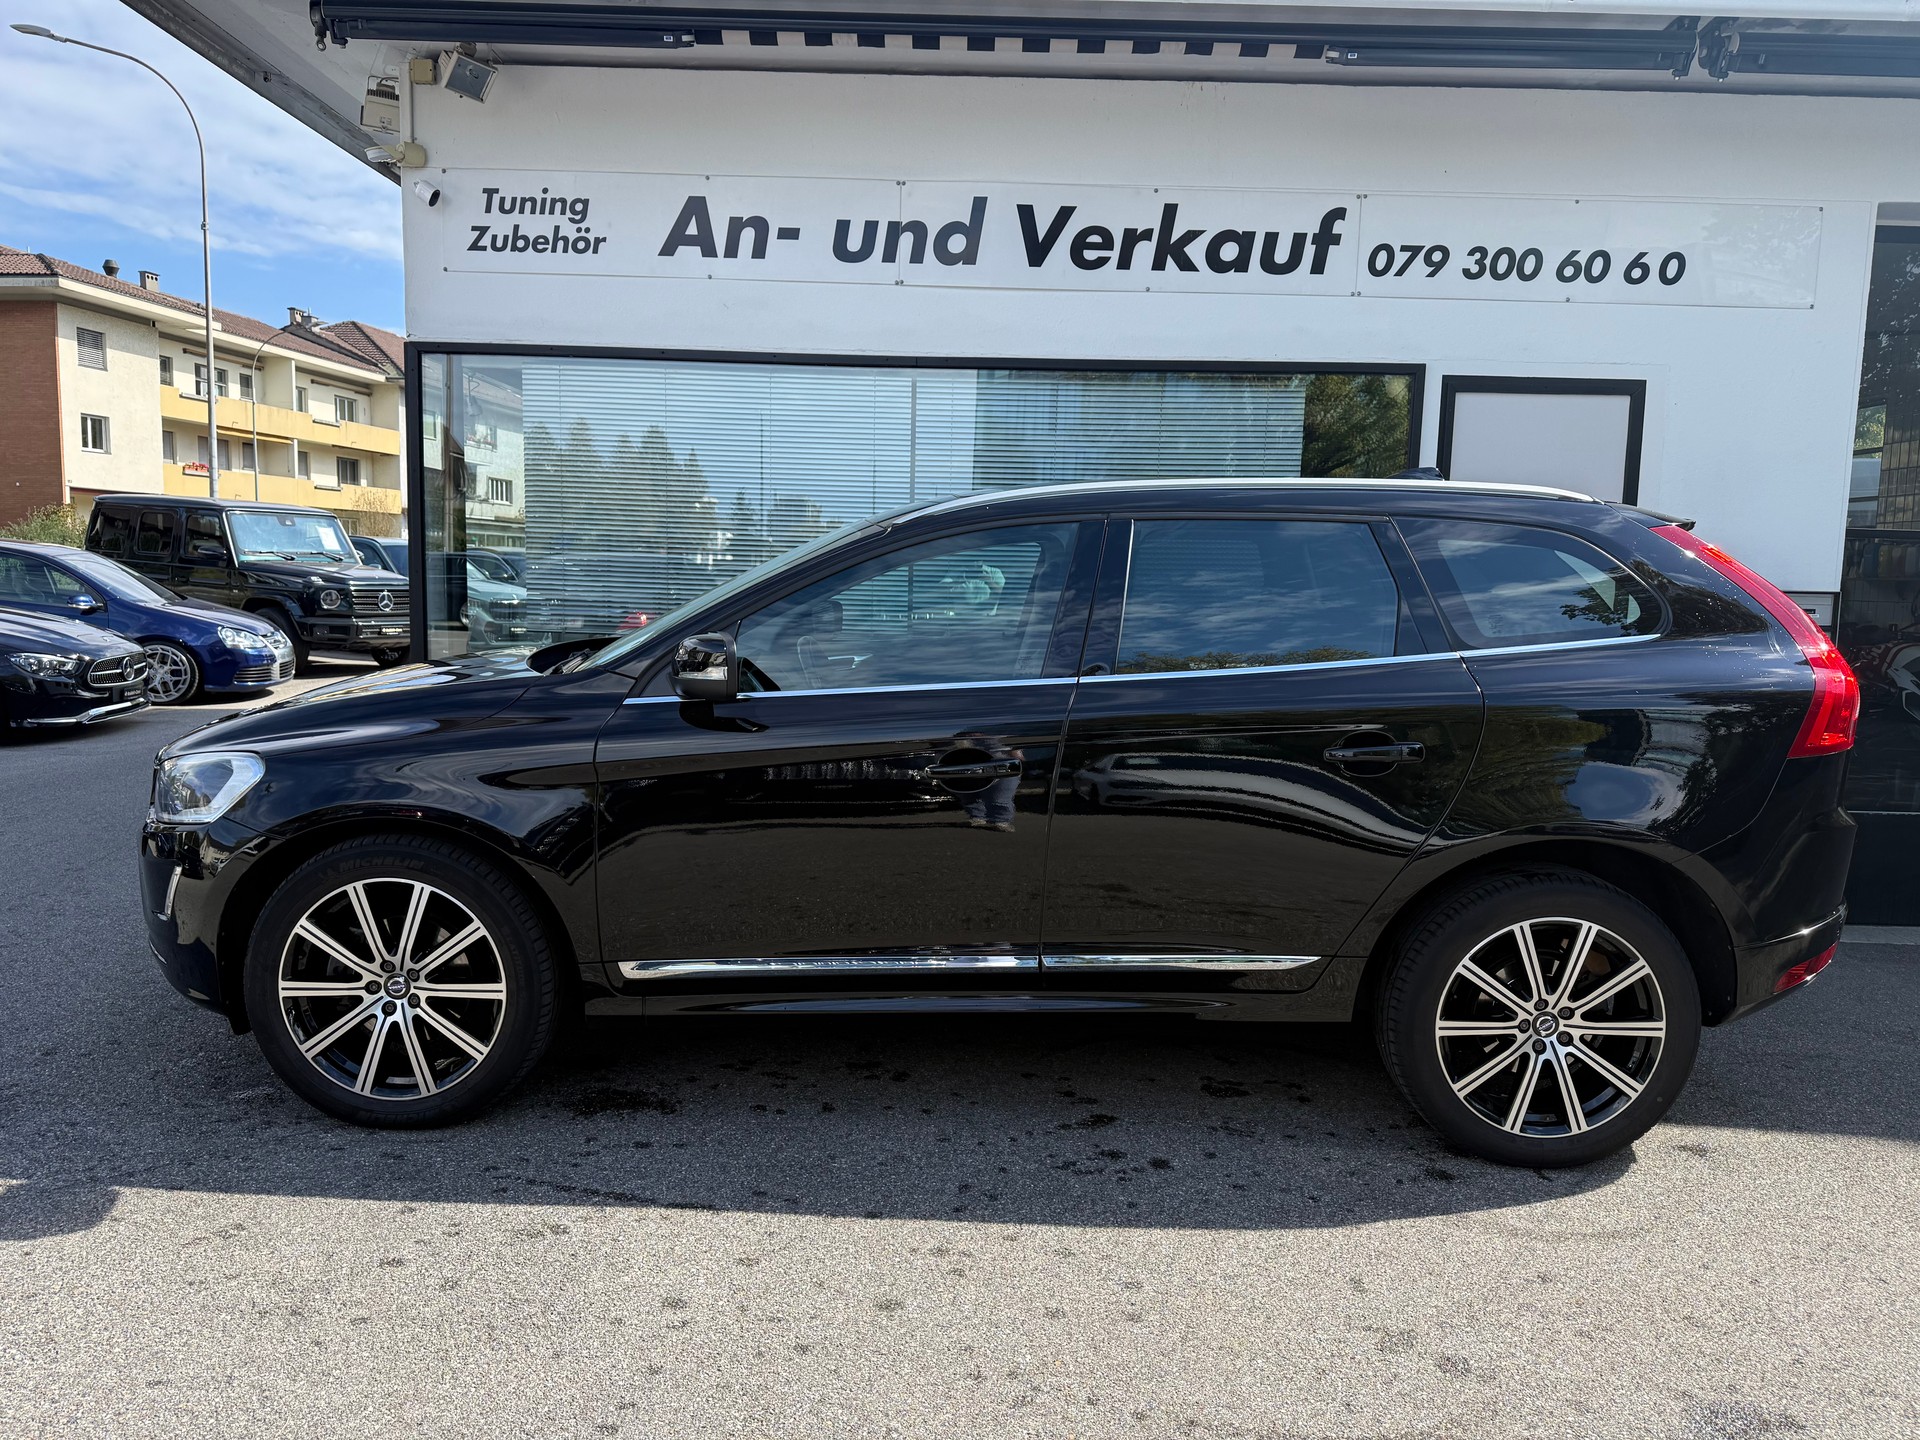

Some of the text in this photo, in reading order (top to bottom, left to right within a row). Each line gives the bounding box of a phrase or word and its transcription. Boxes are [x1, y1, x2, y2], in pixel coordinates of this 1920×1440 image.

[482, 188, 590, 225] Tuning
[467, 226, 607, 256] Zubehör
[658, 195, 1348, 276] An- und Verkauf
[1368, 242, 1687, 286] 079 300 60 60
